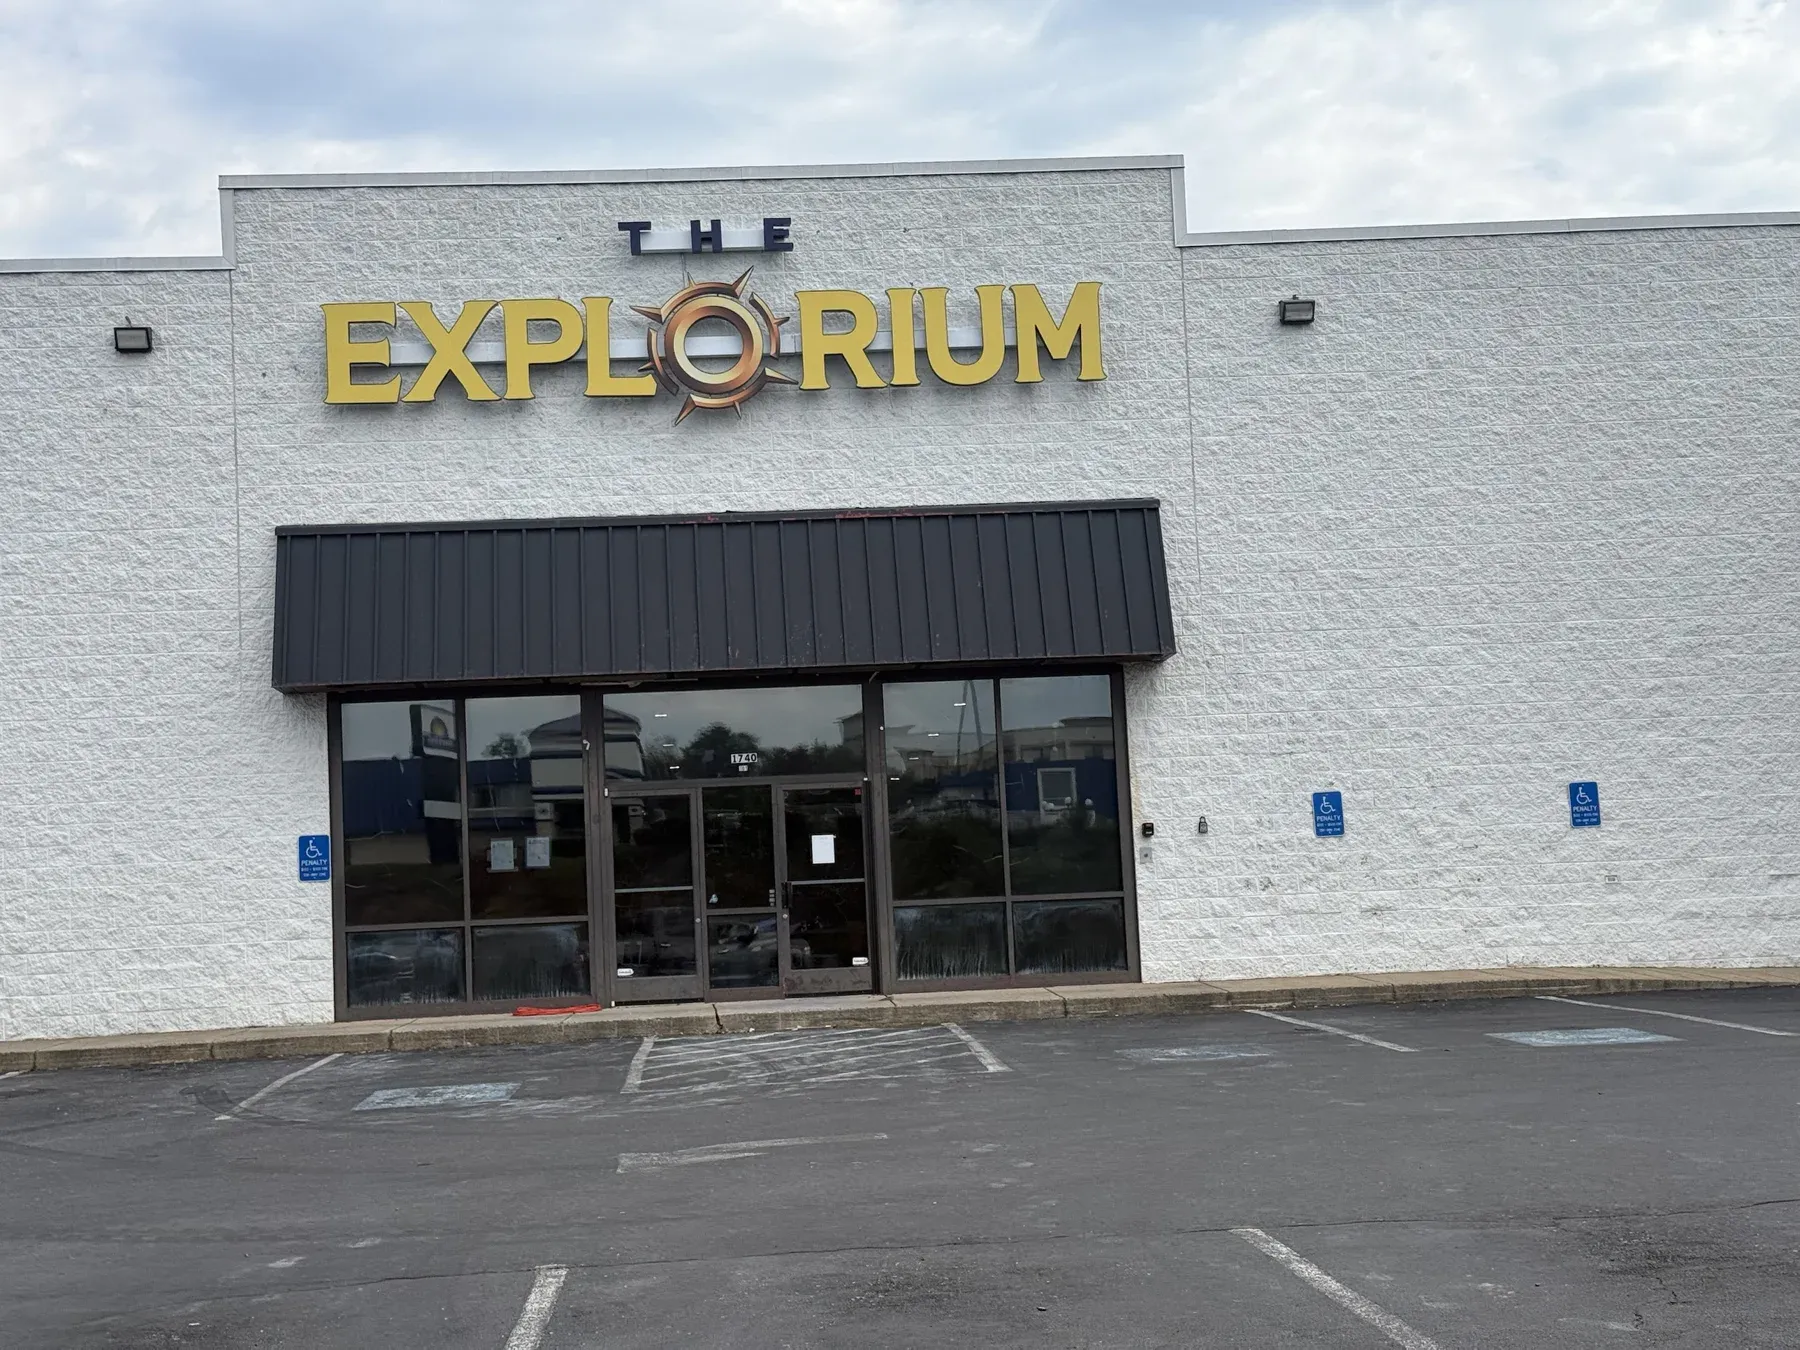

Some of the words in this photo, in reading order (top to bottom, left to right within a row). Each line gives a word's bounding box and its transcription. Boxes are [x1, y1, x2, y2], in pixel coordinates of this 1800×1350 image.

[617, 217, 794, 254] THE
[321, 271, 1108, 418] EXPLORIUM
[732, 753, 757, 763] 1740
